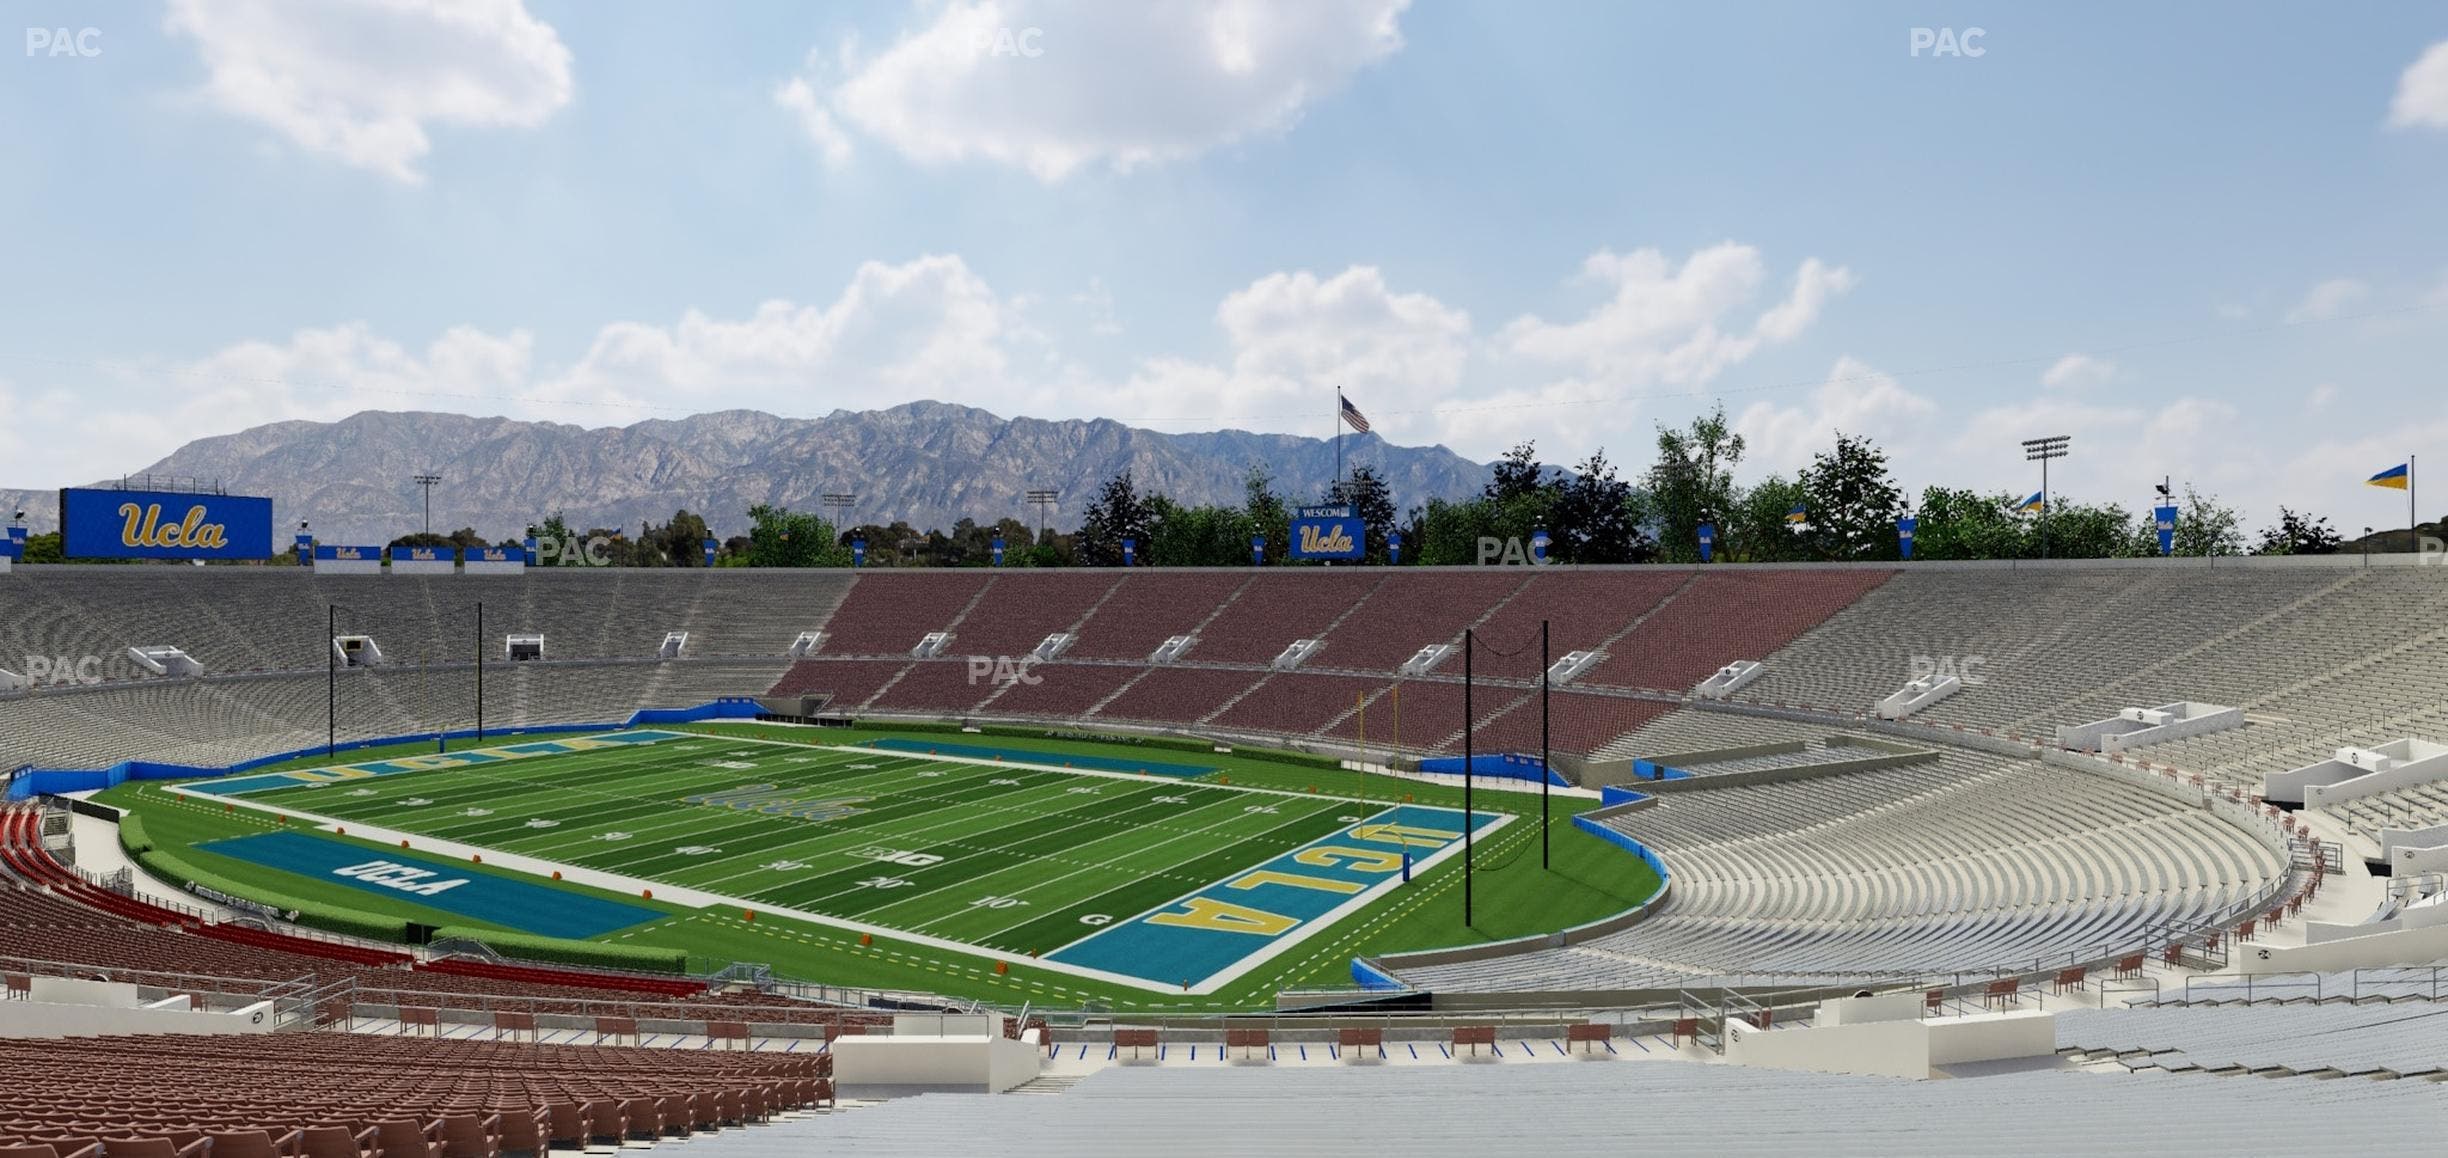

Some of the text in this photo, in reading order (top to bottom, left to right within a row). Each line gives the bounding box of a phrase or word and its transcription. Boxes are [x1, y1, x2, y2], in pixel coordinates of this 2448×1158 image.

[118, 502, 228, 548] Ucla
[1303, 508, 1340, 518] WESCOM
[1300, 525, 1354, 552] Ucla
[332, 859, 471, 896] UCLA
[1142, 823, 1465, 936] UCLA
[968, 895, 1018, 909] 10
[1079, 913, 1114, 925] G
